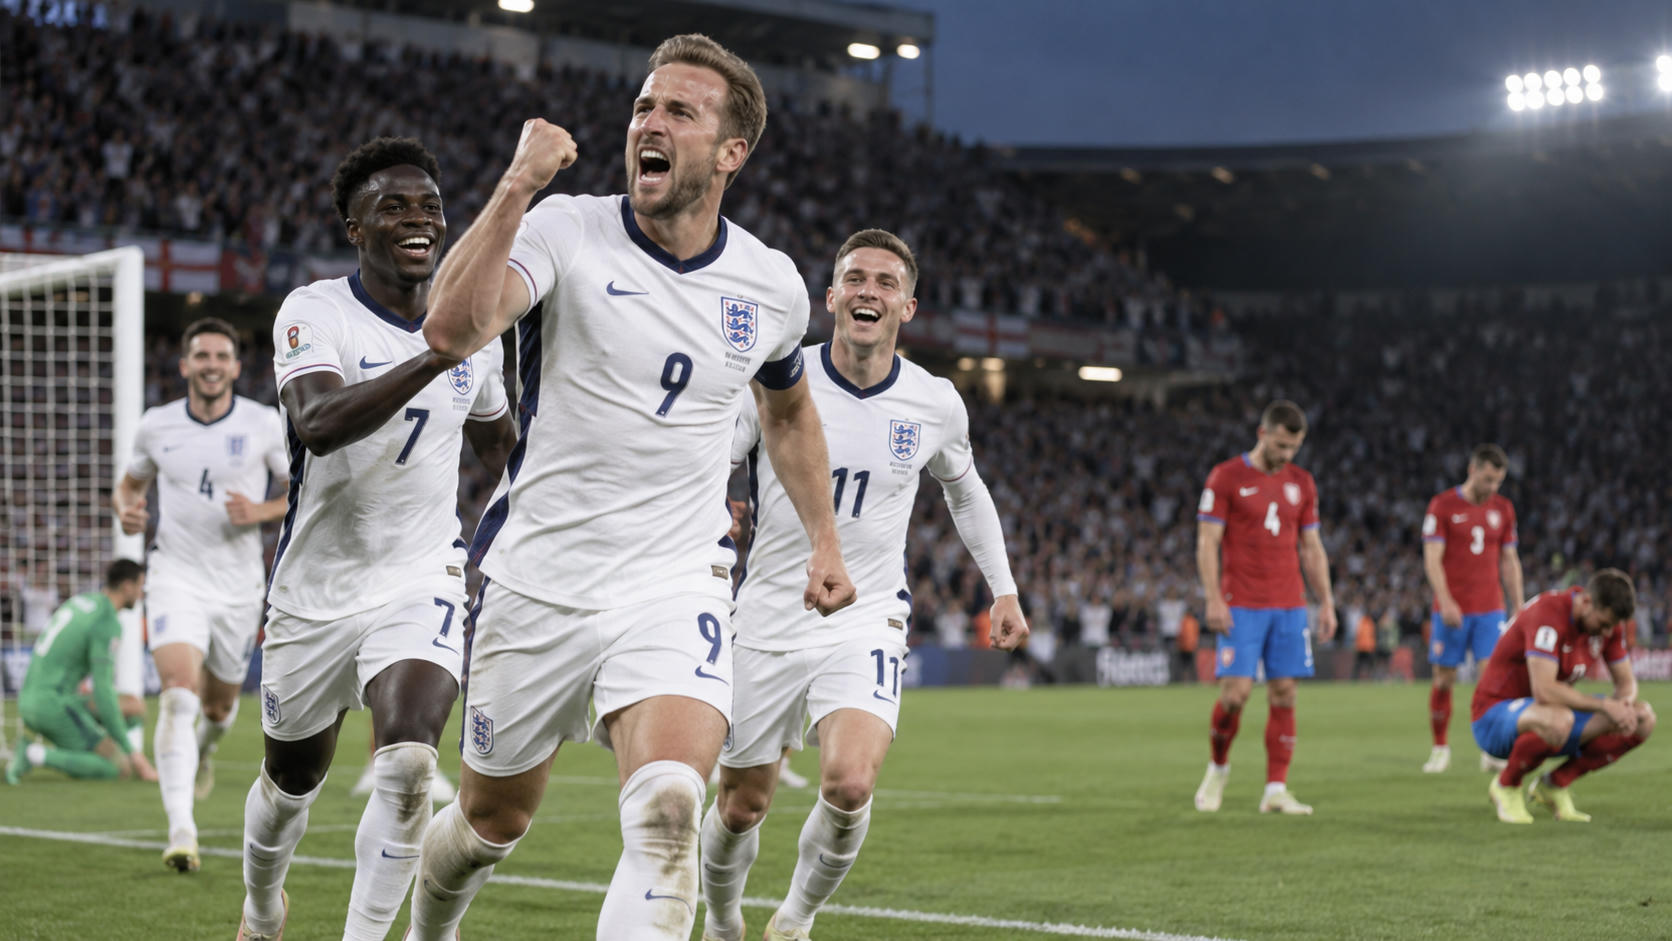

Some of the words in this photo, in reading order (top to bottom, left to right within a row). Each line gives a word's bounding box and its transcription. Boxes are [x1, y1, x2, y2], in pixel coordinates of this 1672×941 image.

[655, 352, 693, 417] 9
[396, 408, 430, 465] 7
[832, 467, 870, 518] 11
[1264, 501, 1281, 536] 4
[1470, 525, 1485, 555] 3
[434, 597, 455, 637] 7
[697, 612, 721, 665] 9
[871, 649, 898, 698] 11
